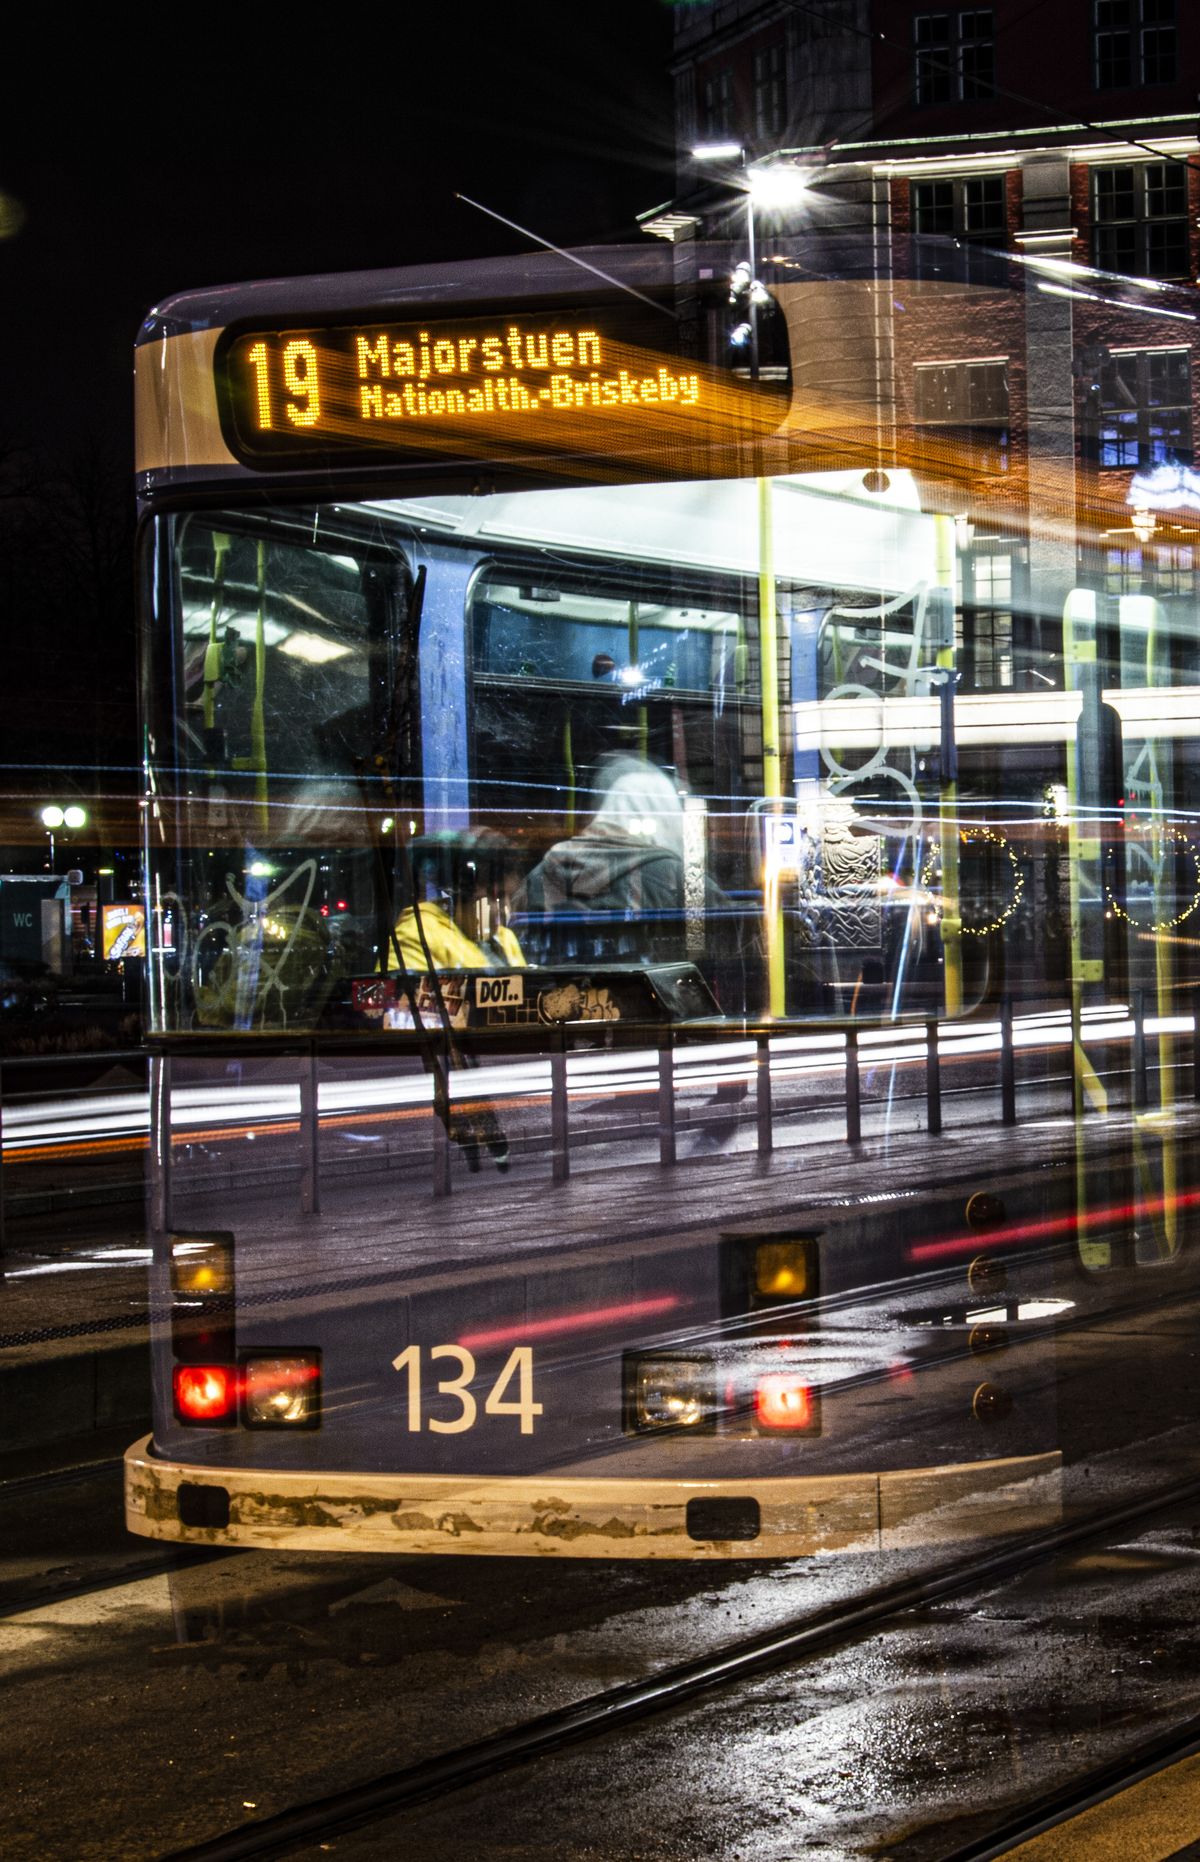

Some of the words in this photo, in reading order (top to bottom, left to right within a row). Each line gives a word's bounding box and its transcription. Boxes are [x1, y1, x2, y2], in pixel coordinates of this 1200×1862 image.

[356, 327, 600, 378] Majorstuen
[249, 340, 320, 428] 19
[360, 368, 699, 418] Nationalth.-Briskeby
[12, 912, 33, 927] WC
[391, 1344, 543, 1435] 134
